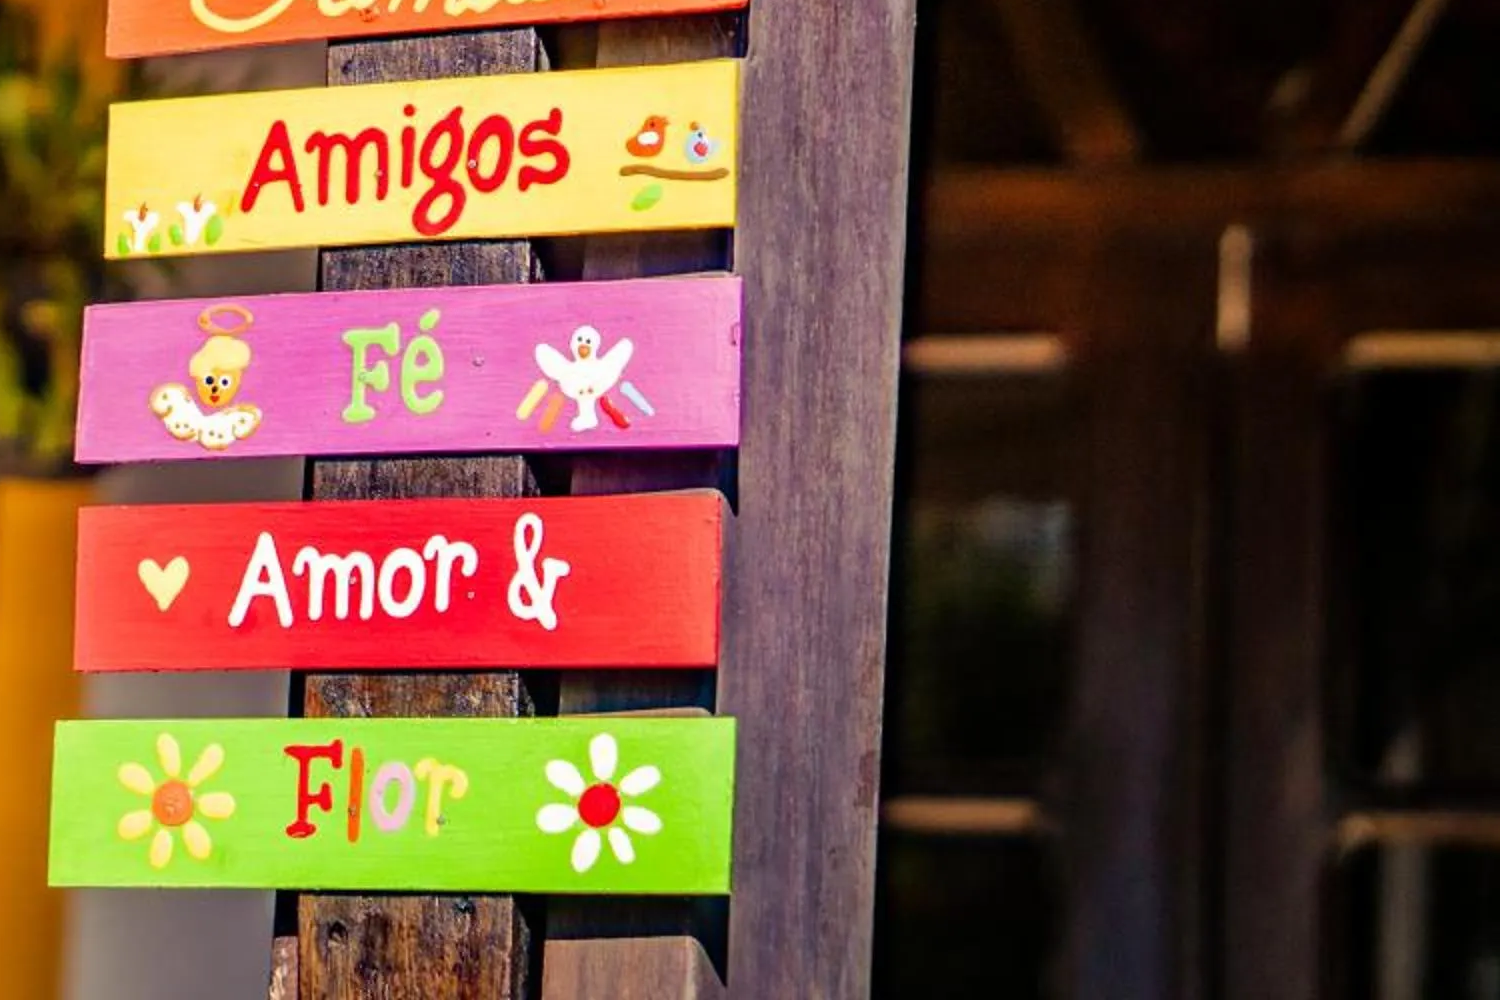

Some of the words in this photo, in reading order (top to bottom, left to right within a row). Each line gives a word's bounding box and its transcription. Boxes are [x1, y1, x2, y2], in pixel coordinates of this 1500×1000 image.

[240, 103, 571, 237] Amigos
[342, 308, 444, 424] Fé
[228, 531, 478, 628] Amor
[507, 512, 570, 630] &
[284, 739, 468, 843] Flor
